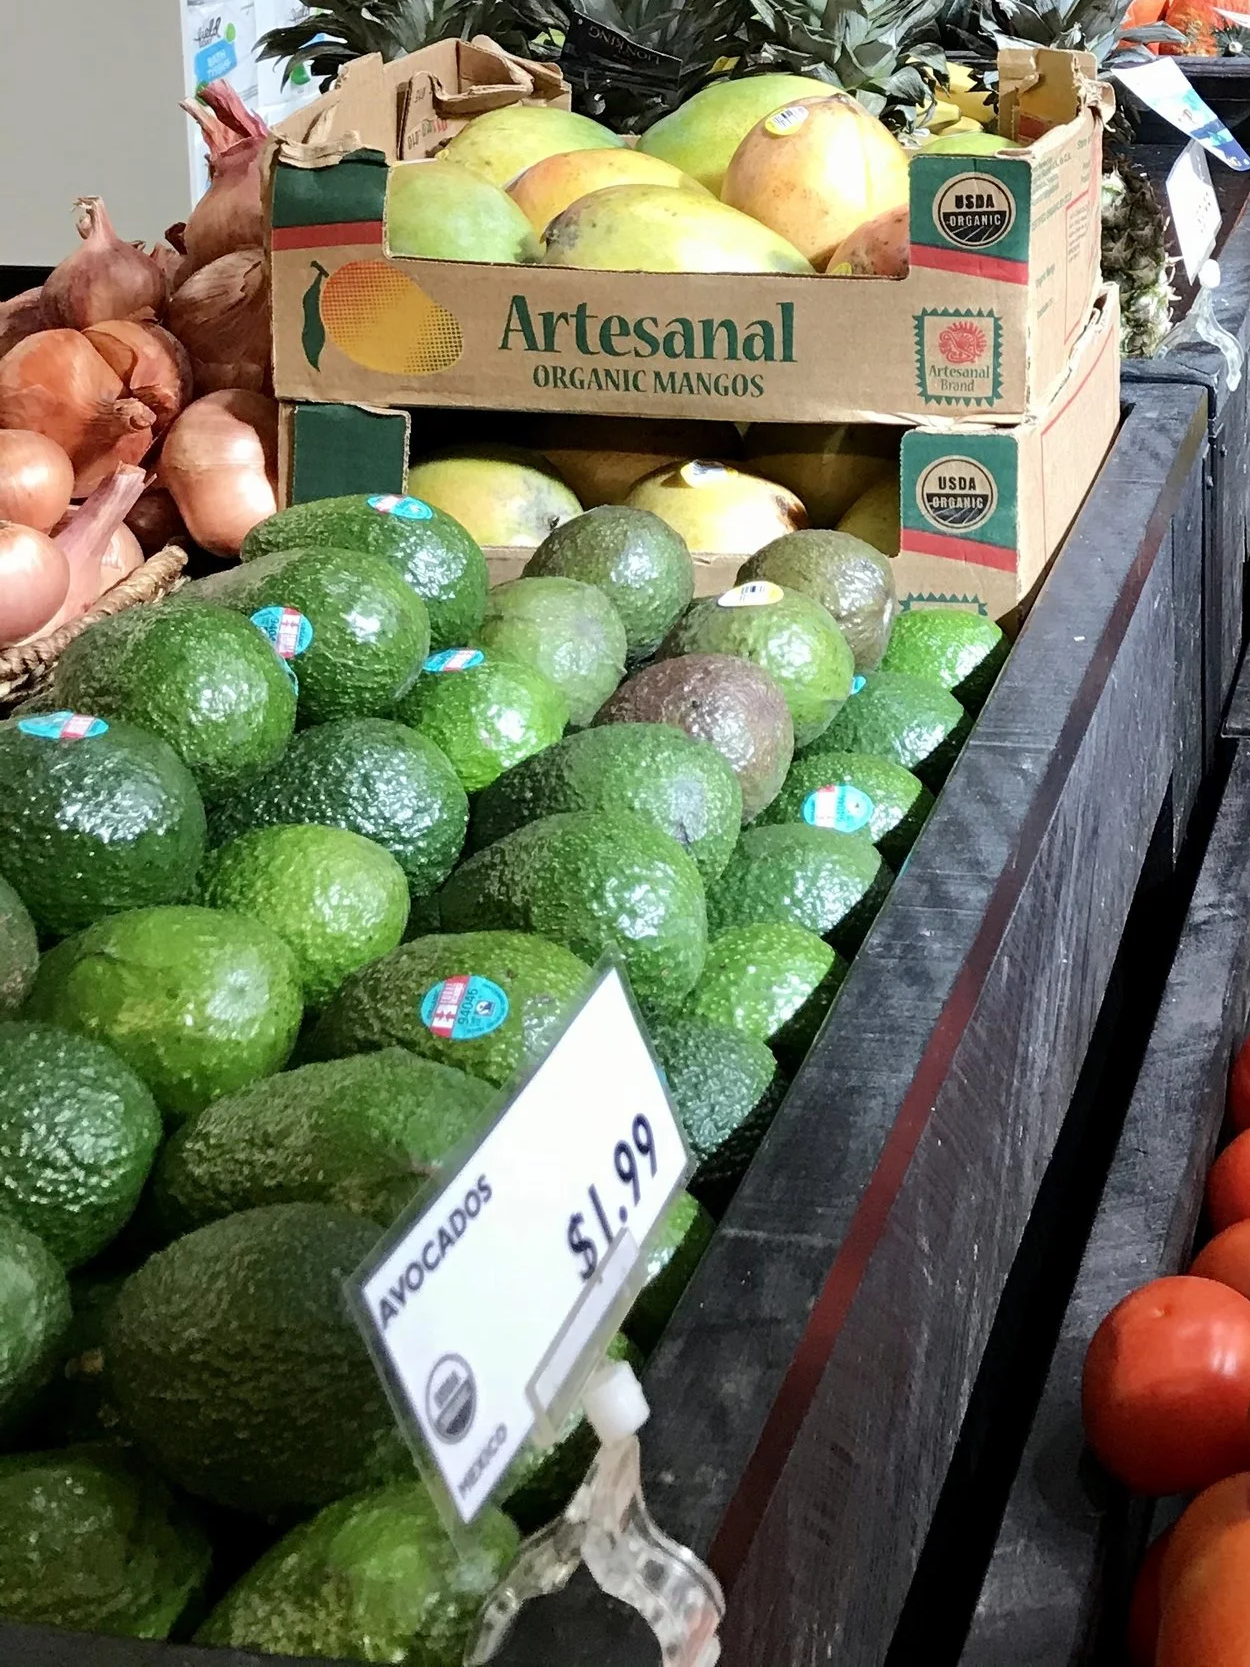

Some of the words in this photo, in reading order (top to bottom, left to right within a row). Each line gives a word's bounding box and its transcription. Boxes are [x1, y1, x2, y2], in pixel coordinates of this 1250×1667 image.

[955, 194, 994, 209] USDA
[950, 214, 1001, 227] ORGANIC
[498, 294, 798, 363] Artesanal
[533, 365, 647, 394] ORGANIC
[653, 371, 764, 398] MANGOS
[929, 365, 990, 379] Artesanal
[940, 379, 975, 392] Brand
[938, 476, 976, 491] USDA
[932, 496, 984, 509] ORGANIC
[457, 989, 479, 1025] 94046
[568, 1113, 658, 1281] $1.99
[378, 1174, 494, 1332] AVOCADOS
[458, 1421, 508, 1500] MEXICO
